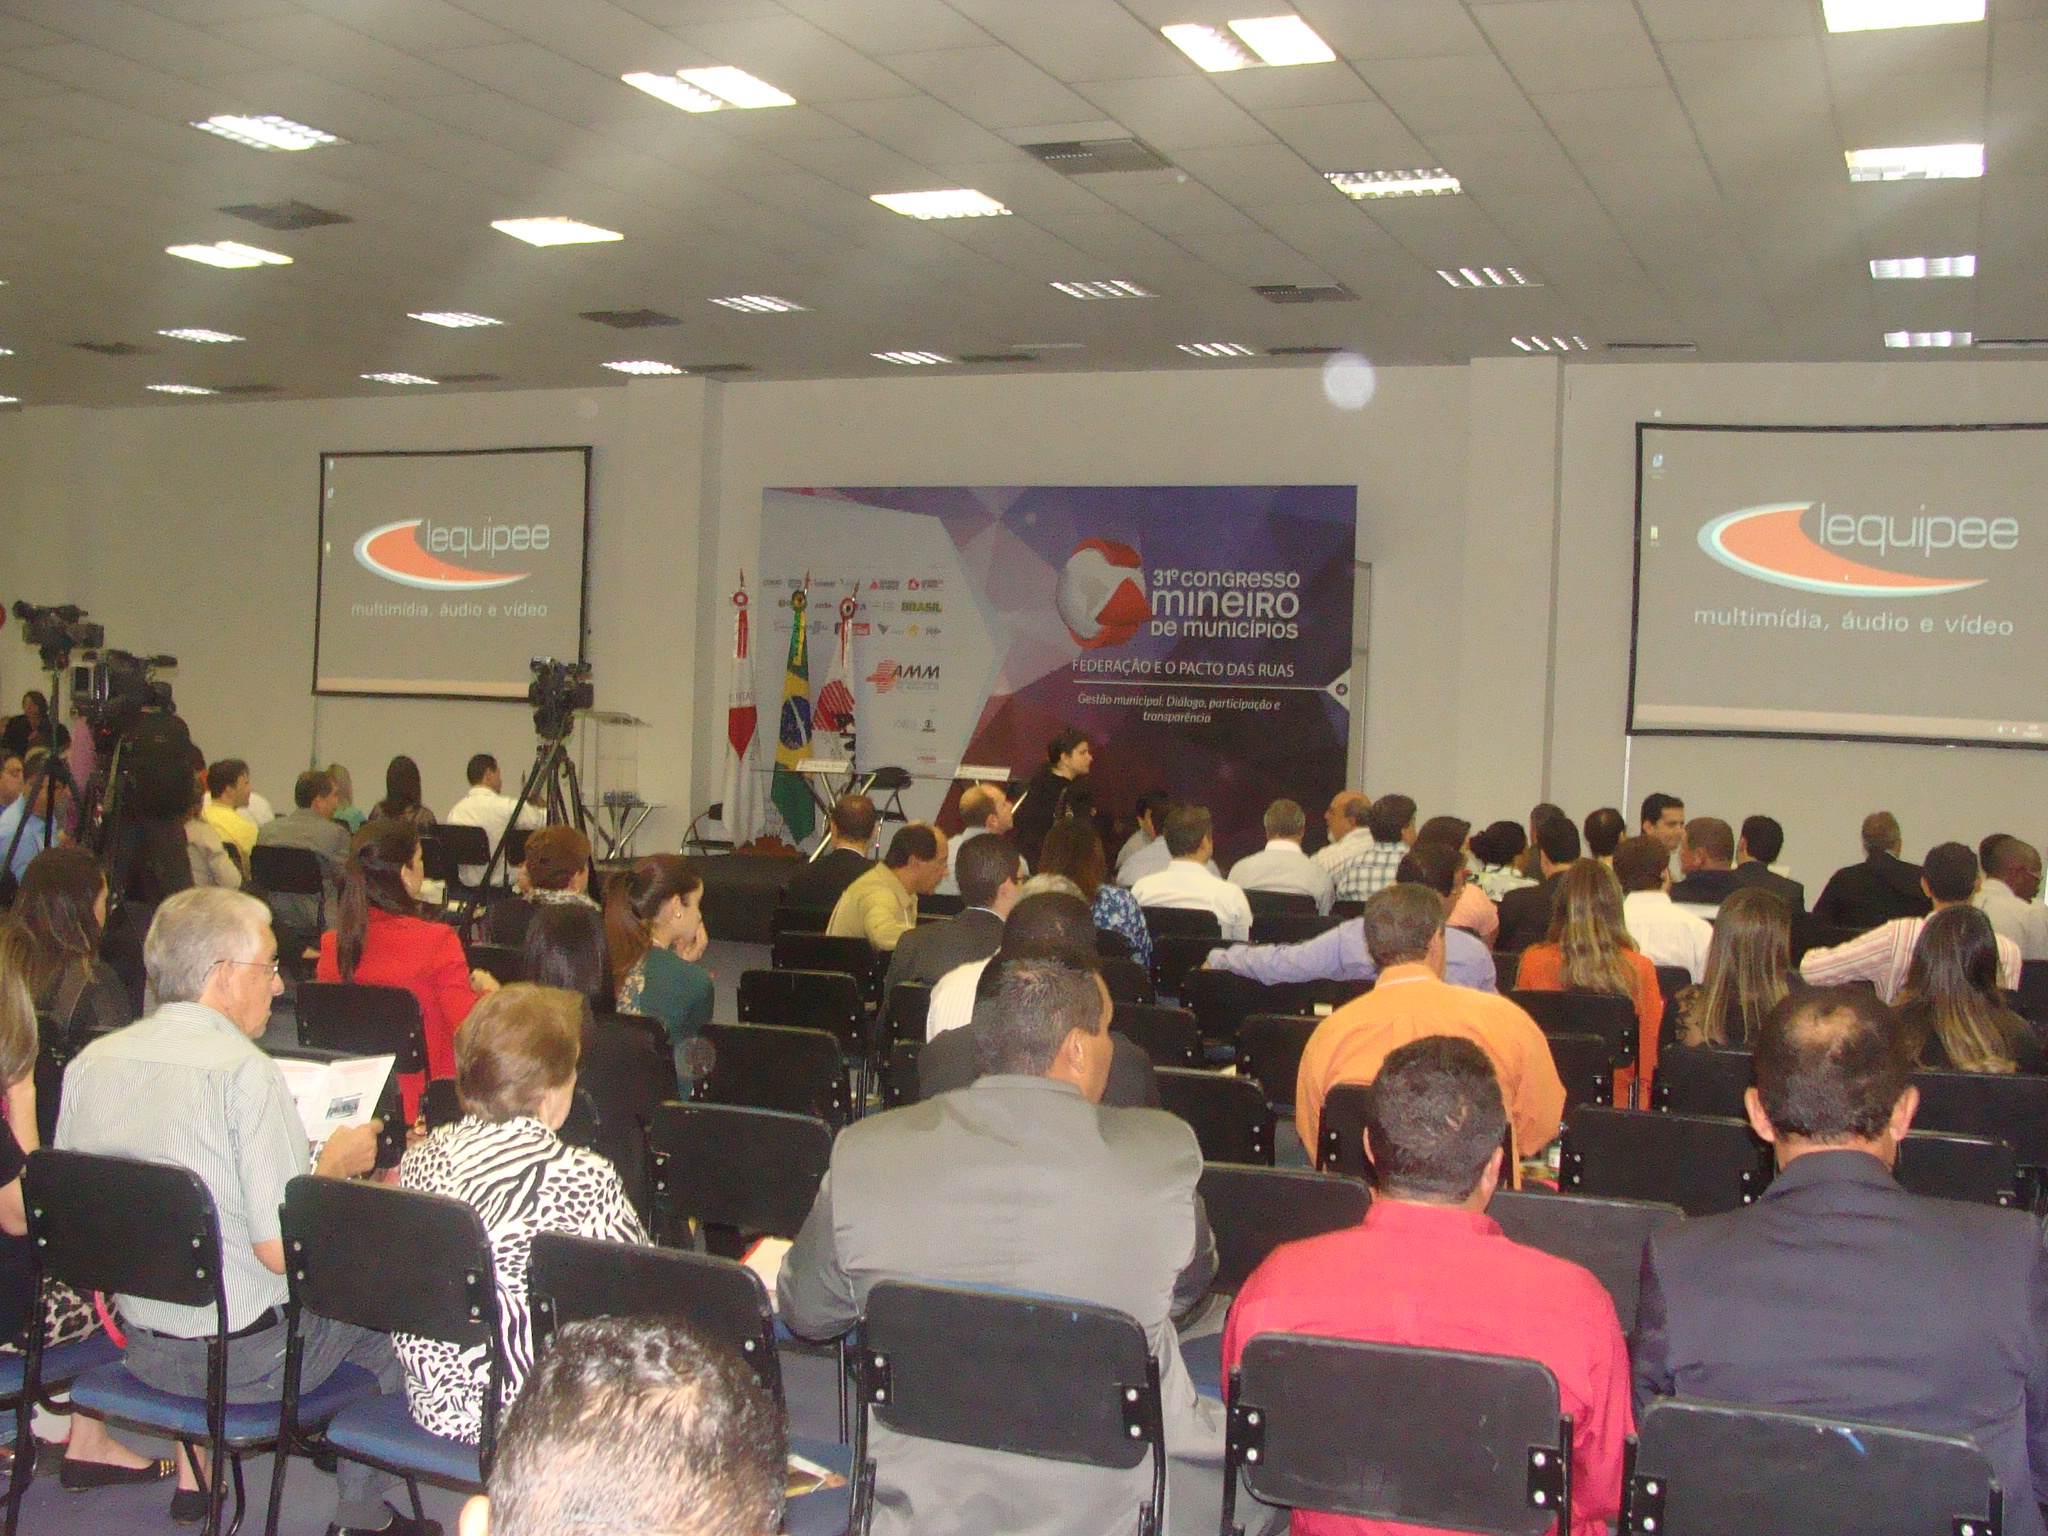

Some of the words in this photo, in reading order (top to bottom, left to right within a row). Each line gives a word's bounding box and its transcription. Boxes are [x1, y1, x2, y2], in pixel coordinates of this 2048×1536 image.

[426, 517, 550, 559] lequipee
[1819, 502, 2019, 558] lequipee
[440, 602, 482, 617] áudio
[488, 605, 498, 617] e
[504, 601, 548, 618] vídeo
[1694, 607, 1830, 631] multimídia,
[1841, 610, 1909, 633] áudio
[1919, 619, 1934, 634] e
[1944, 614, 2014, 636] vídeo
[1072, 658, 1151, 676] FEDERAÇÃO
[1154, 661, 1162, 675] E
[1165, 662, 1176, 676] O
[1179, 662, 1224, 677] PACTO
[1227, 663, 1256, 677] DAS
[1258, 663, 1295, 678] RUAS
[1077, 692, 1112, 705] Gestão
[1208, 697, 1273, 713] participação
[1274, 701, 1281, 711] e
[1143, 710, 1211, 724] transparência
